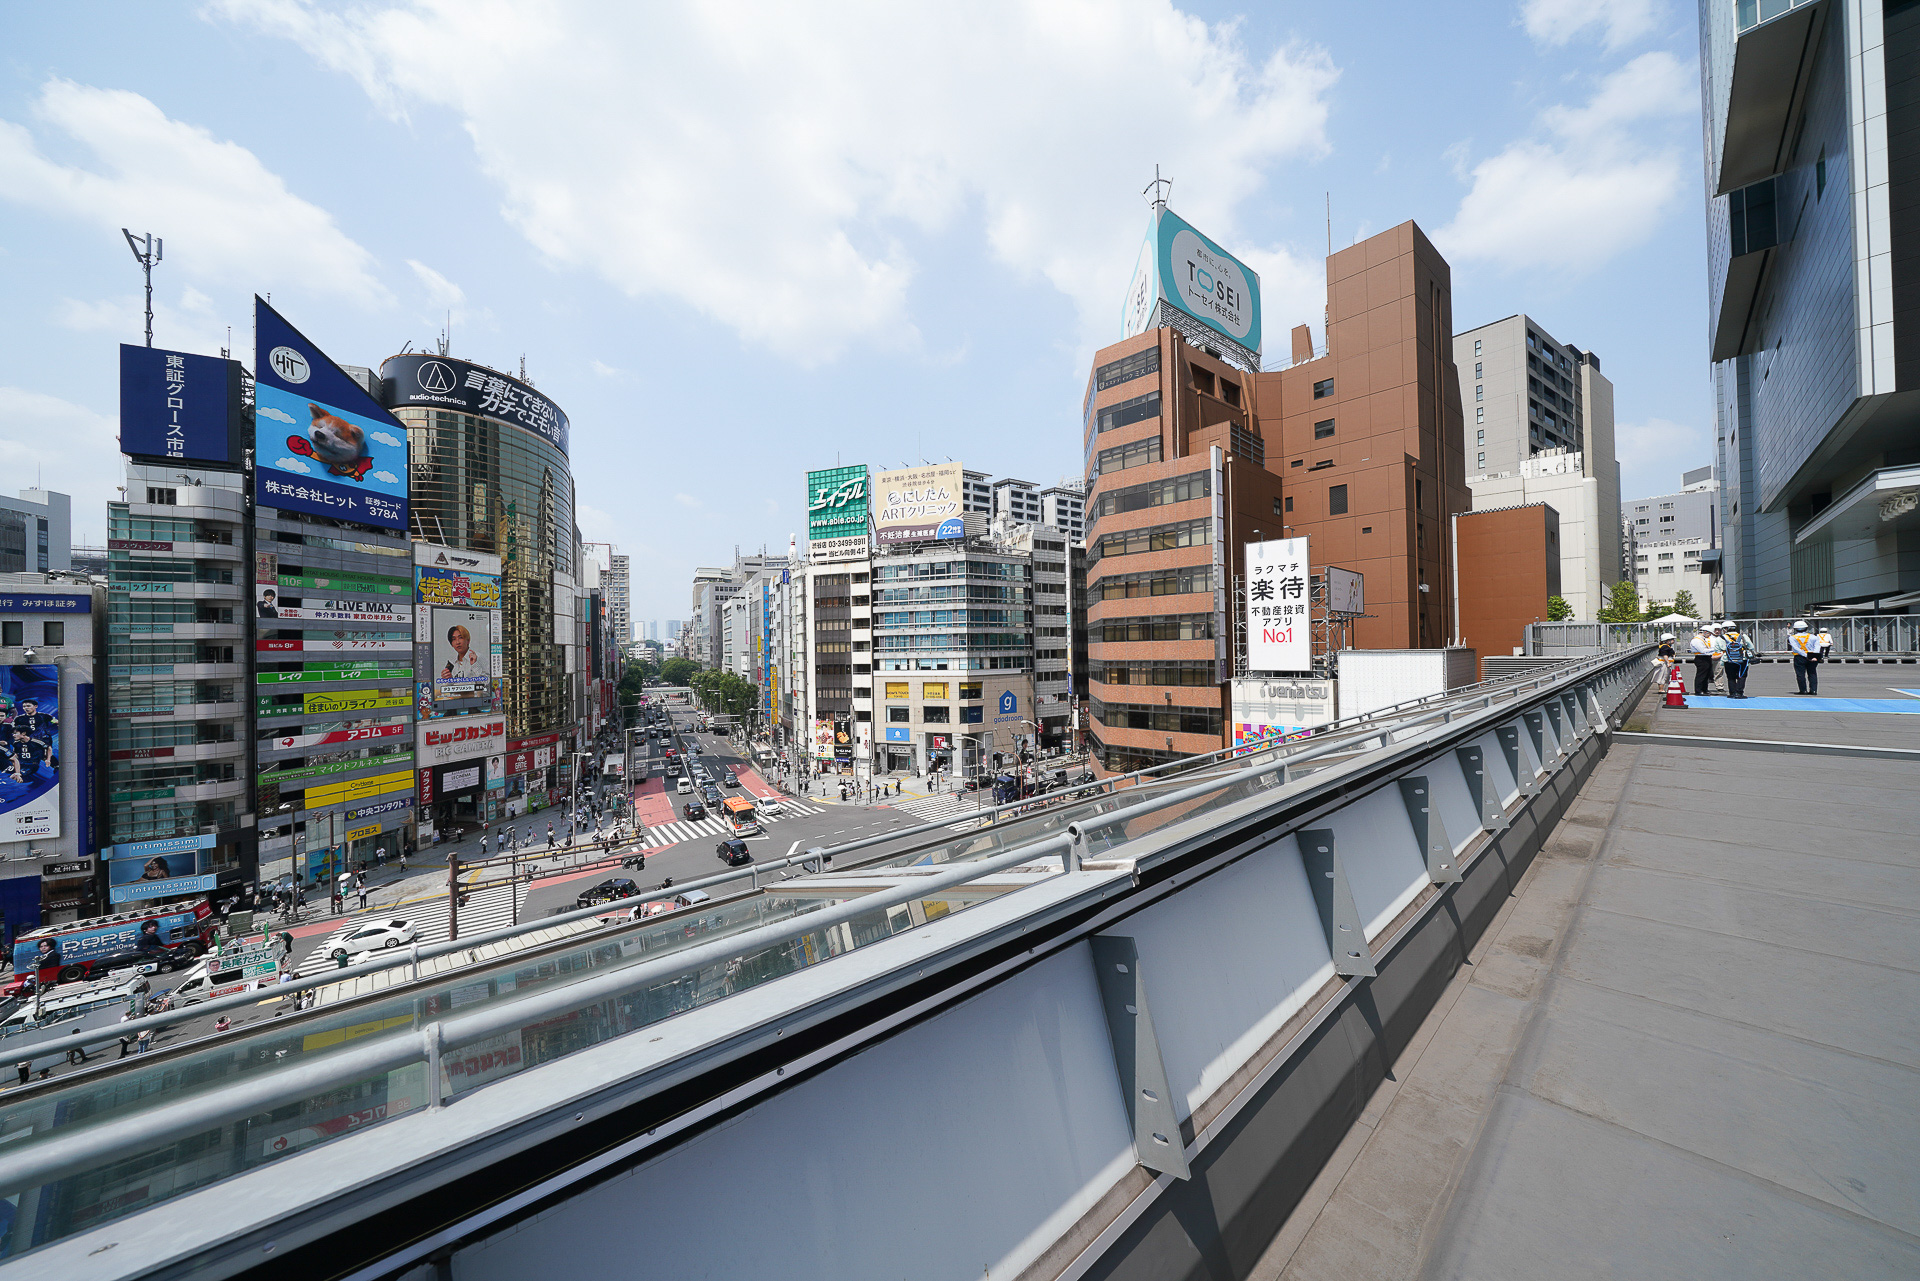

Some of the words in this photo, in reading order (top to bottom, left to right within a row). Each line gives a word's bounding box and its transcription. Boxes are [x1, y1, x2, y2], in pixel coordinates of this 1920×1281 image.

[1187, 260, 1240, 311] TOSEI
[1188, 285, 1240, 326] トーセイ株式会社
[410, 394, 466, 406] audio-technica
[265, 480, 357, 509] 株式会社ヒット
[808, 476, 866, 510] エイブル
[903, 487, 950, 503] にしたん
[365, 496, 402, 510] 証券コード
[369, 506, 399, 520] 378A
[882, 502, 957, 521] ARTクリニック
[810, 514, 865, 528] www.able.co.jp
[120, 542, 168, 551] スヴェンソン
[812, 540, 827, 549] 渋谷店
[1254, 562, 1299, 575] ラクマチ
[1251, 576, 1304, 602] 楽待
[22, 600, 76, 608] みずほ証券
[366, 602, 393, 613] MAX
[1251, 604, 1304, 617] 不動産投資
[1262, 616, 1292, 627] アプリ
[1263, 628, 1292, 644] No.1
[278, 673, 302, 681] レイク
[309, 700, 377, 712] 住まいのリライフ
[1004, 696, 1012, 710] g
[994, 714, 1024, 724] goodroom
[348, 728, 382, 740] アコム
[424, 722, 504, 746] ビックカメラ
[320, 758, 381, 774] マインドフルネス
[357, 800, 404, 817] 中央コンタクト
[16, 827, 50, 835] MIZUHO
[350, 826, 378, 838] プロミス
[132, 838, 199, 850] intimissimi
[131, 880, 198, 894] intimissimi
[62, 930, 136, 953] DOPE
[222, 952, 272, 969] 長尾たかし
